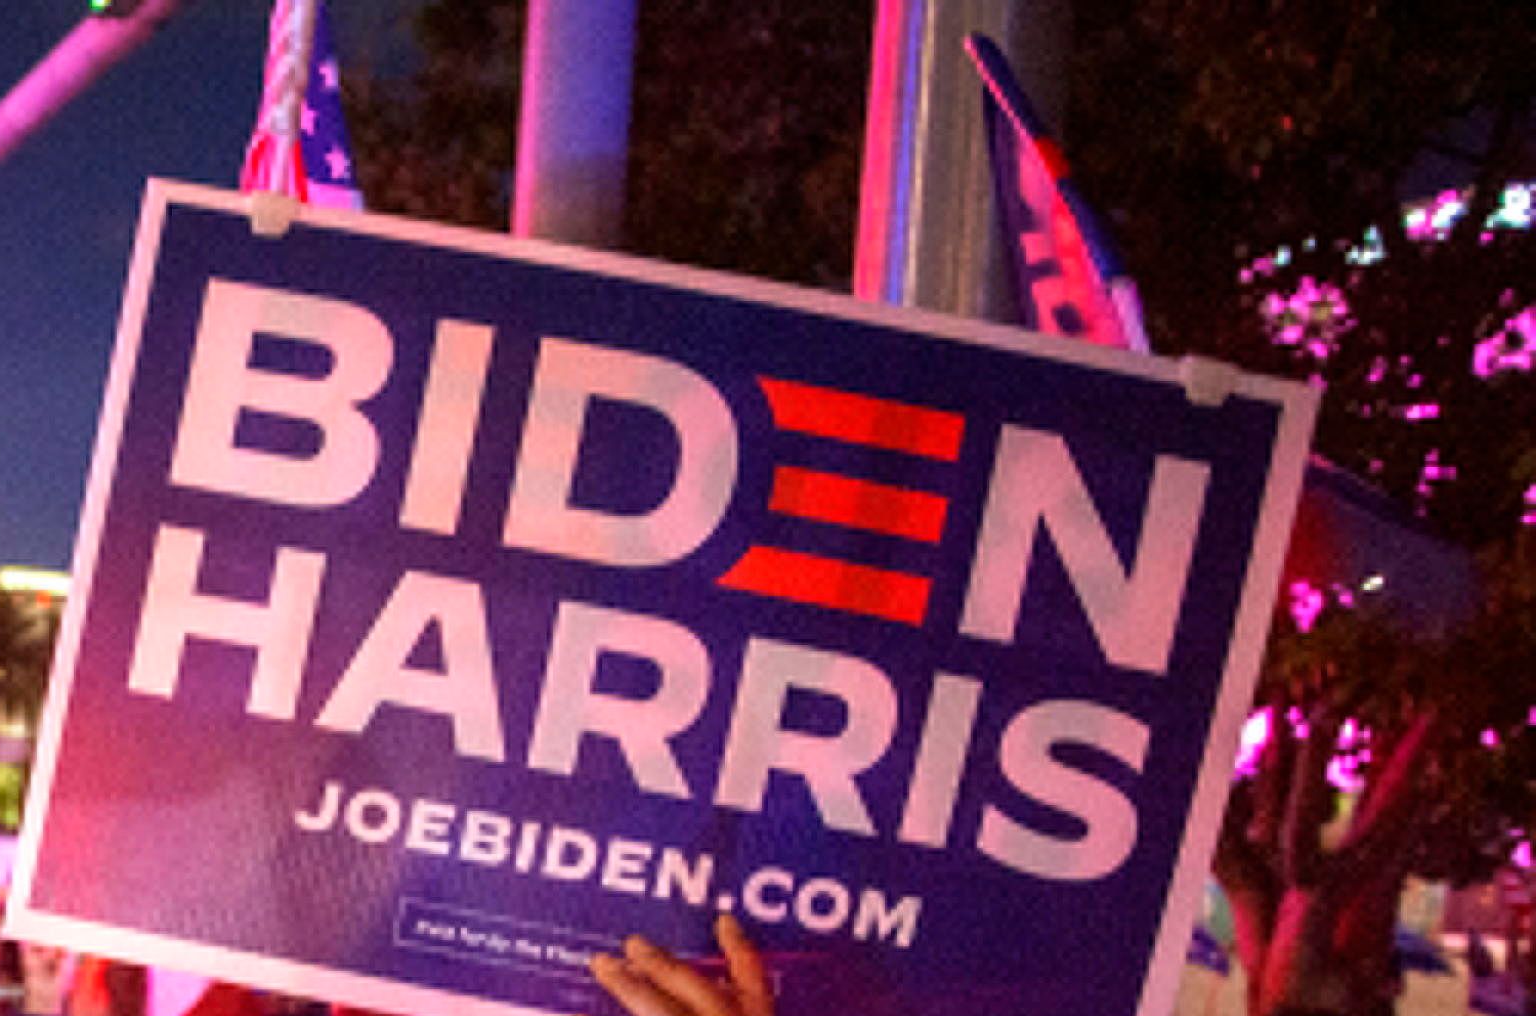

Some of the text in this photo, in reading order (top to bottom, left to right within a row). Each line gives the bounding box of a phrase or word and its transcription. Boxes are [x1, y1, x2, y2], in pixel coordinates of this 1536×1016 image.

[169, 278, 1212, 676] BIDEN
[126, 525, 1153, 881] HARRIS
[295, 782, 924, 948] JOEBIDEN.COM
